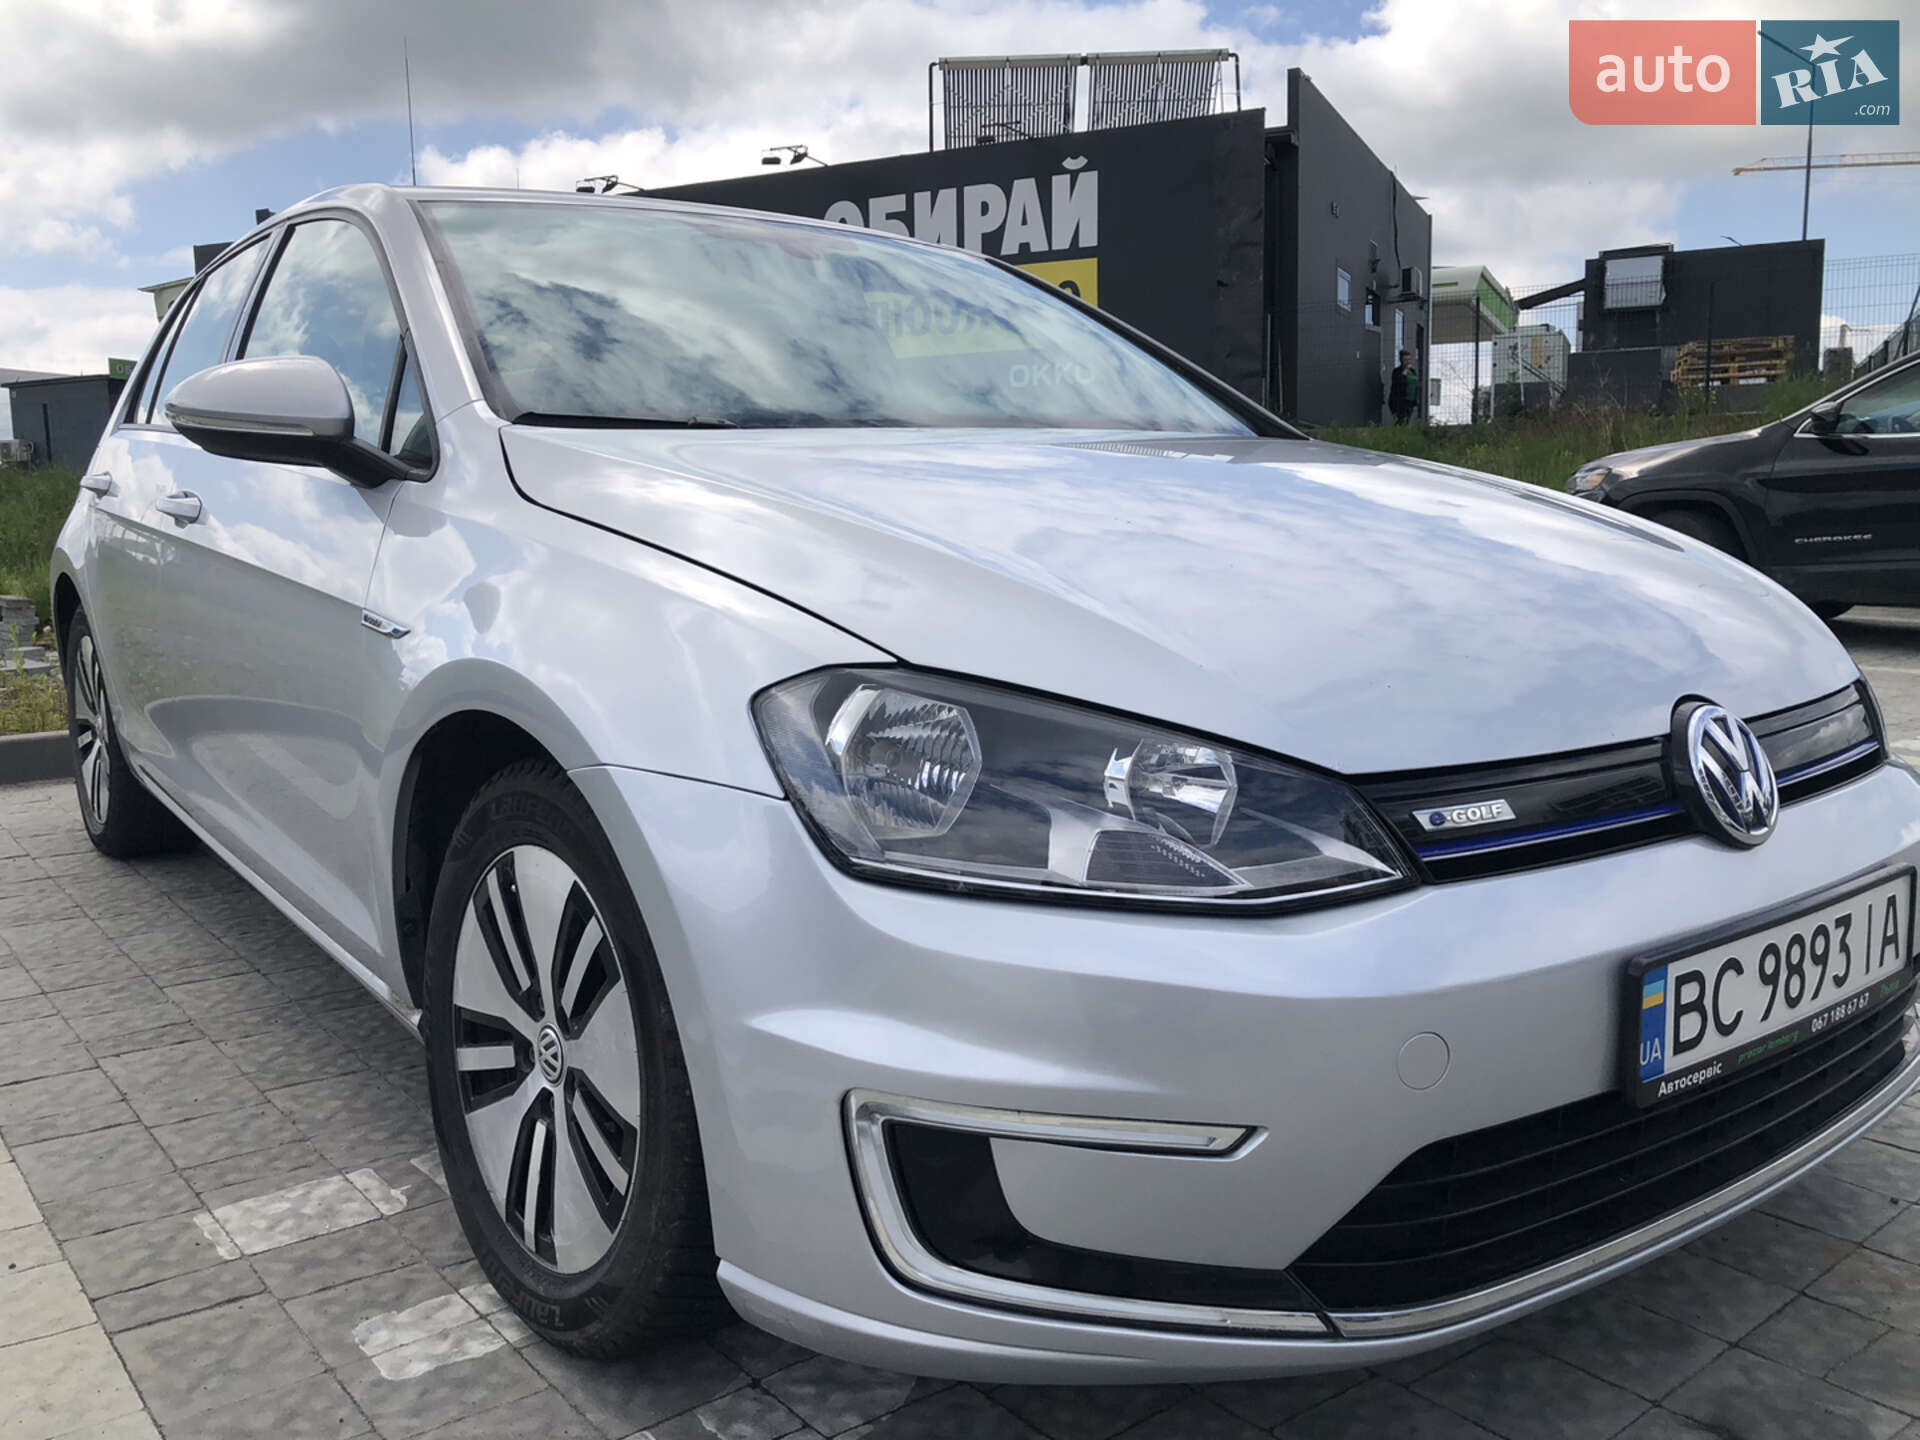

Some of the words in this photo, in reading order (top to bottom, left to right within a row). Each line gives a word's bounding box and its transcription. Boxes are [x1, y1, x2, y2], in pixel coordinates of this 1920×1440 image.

[1758, 911, 1853, 1024] 9893
[1811, 1012, 1829, 1033] 067
[1639, 1038, 1662, 1066] UA
[1658, 1060, 1723, 1098] Автосервіс
